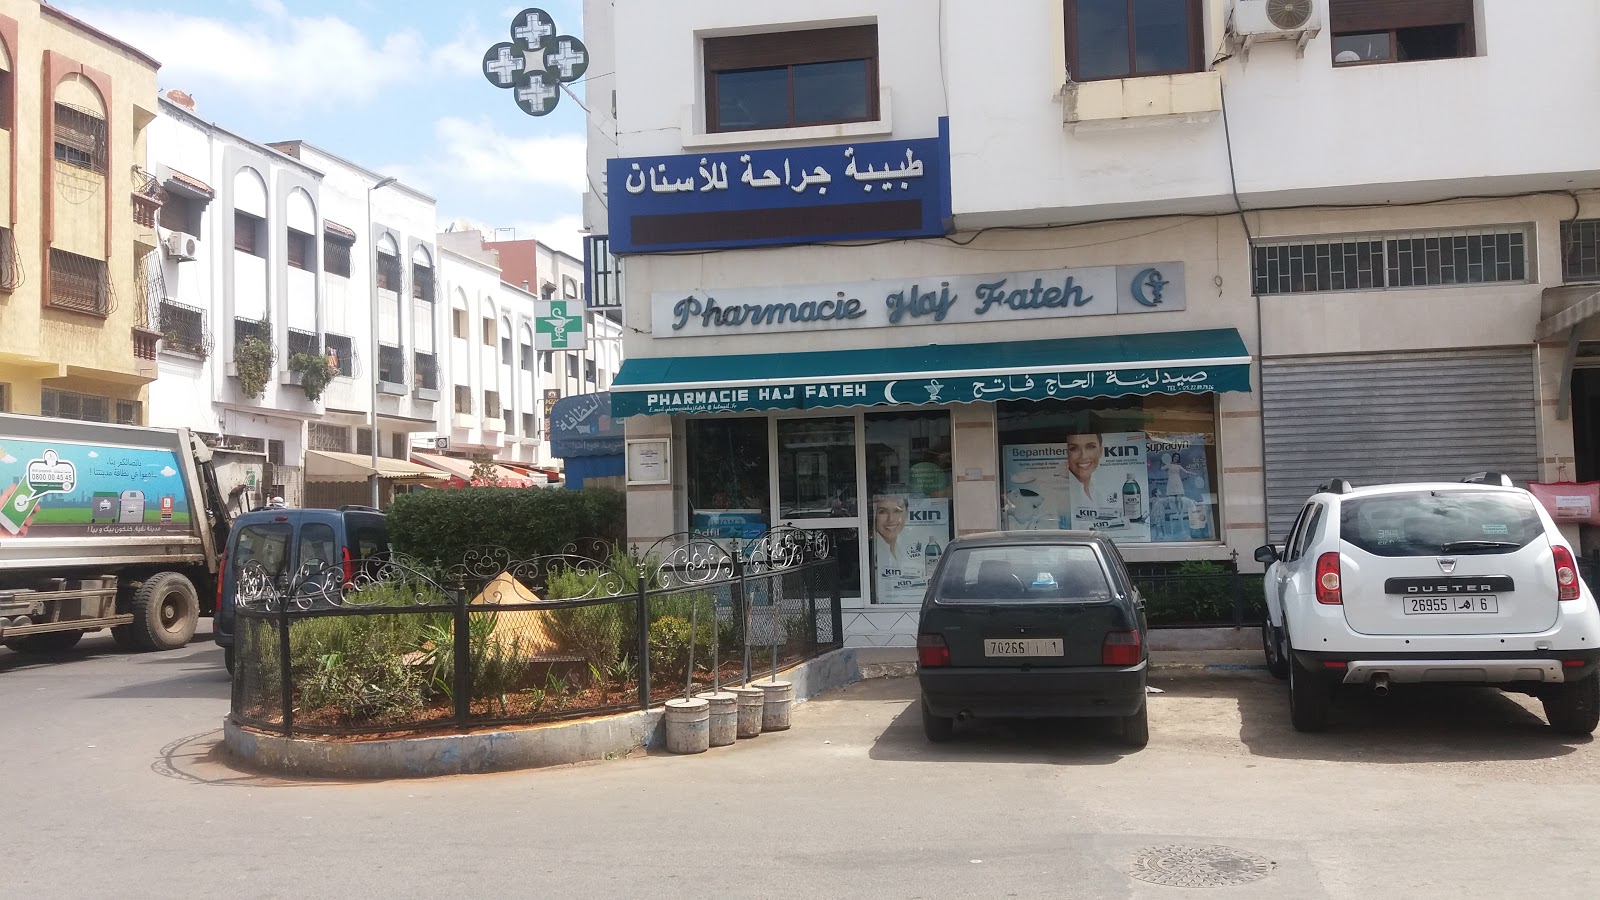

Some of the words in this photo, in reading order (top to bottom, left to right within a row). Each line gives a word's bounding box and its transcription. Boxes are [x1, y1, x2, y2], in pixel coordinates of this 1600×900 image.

[625, 157, 729, 194] للأسنان
[740, 154, 832, 195] جراحة
[845, 146, 924, 192] طبيبة
[672, 291, 867, 331] Pharmacie
[886, 281, 957, 324] Haj
[975, 276, 1093, 315] Fateh
[647, 389, 749, 406] PHARMACIE
[759, 387, 795, 400] HAJ
[805, 384, 867, 398] FATEH
[972, 374, 1035, 398] فاتح
[1045, 371, 1095, 395] الحاج
[555, 393, 603, 431] النظافة
[1145, 440, 1189, 453] Supradyn
[1407, 584, 1491, 593] DUSTER
[1411, 599, 1448, 611] 26955
[1480, 598, 1488, 610] 6
[990, 641, 1025, 654] 70266
